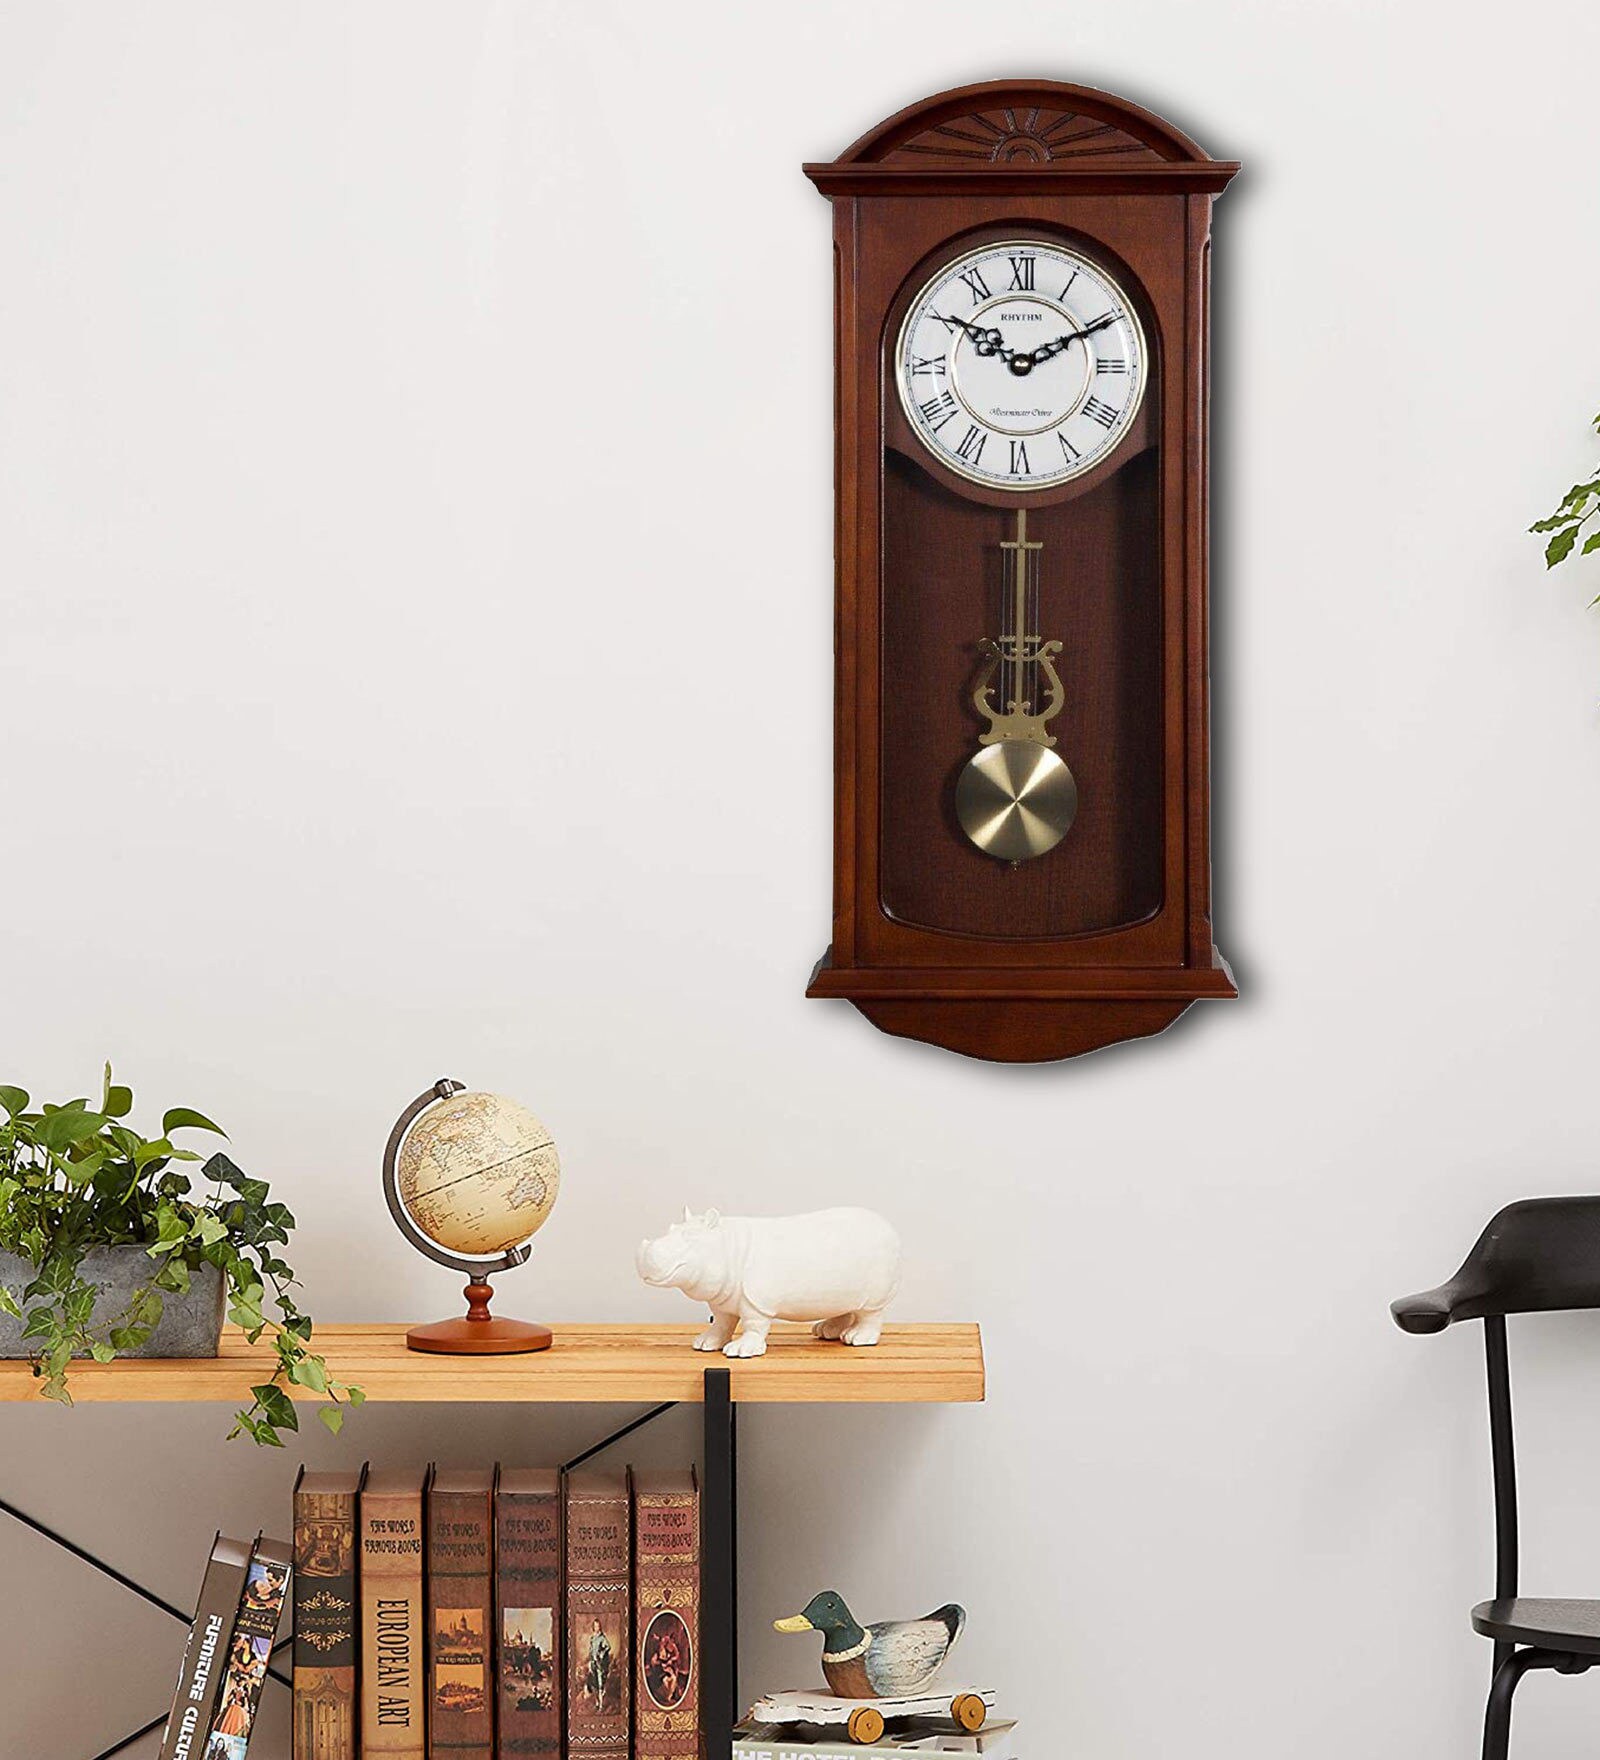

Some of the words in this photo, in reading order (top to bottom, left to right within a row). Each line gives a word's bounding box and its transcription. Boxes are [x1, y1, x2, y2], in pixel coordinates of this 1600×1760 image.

[958, 266, 992, 305] XI
[1007, 256, 1036, 291] XII
[1058, 271, 1079, 302] I
[1000, 313, 1043, 321] RHYTHM
[912, 354, 946, 377] IX
[1096, 357, 1126, 376] III
[1080, 396, 1120, 430] IIII
[956, 424, 988, 465] VII
[1057, 431, 1081, 464] V
[189, 1614, 223, 1701] FURNITURE
[377, 1599, 410, 1687] EUROPEAN
[377, 1695, 410, 1728] ART
